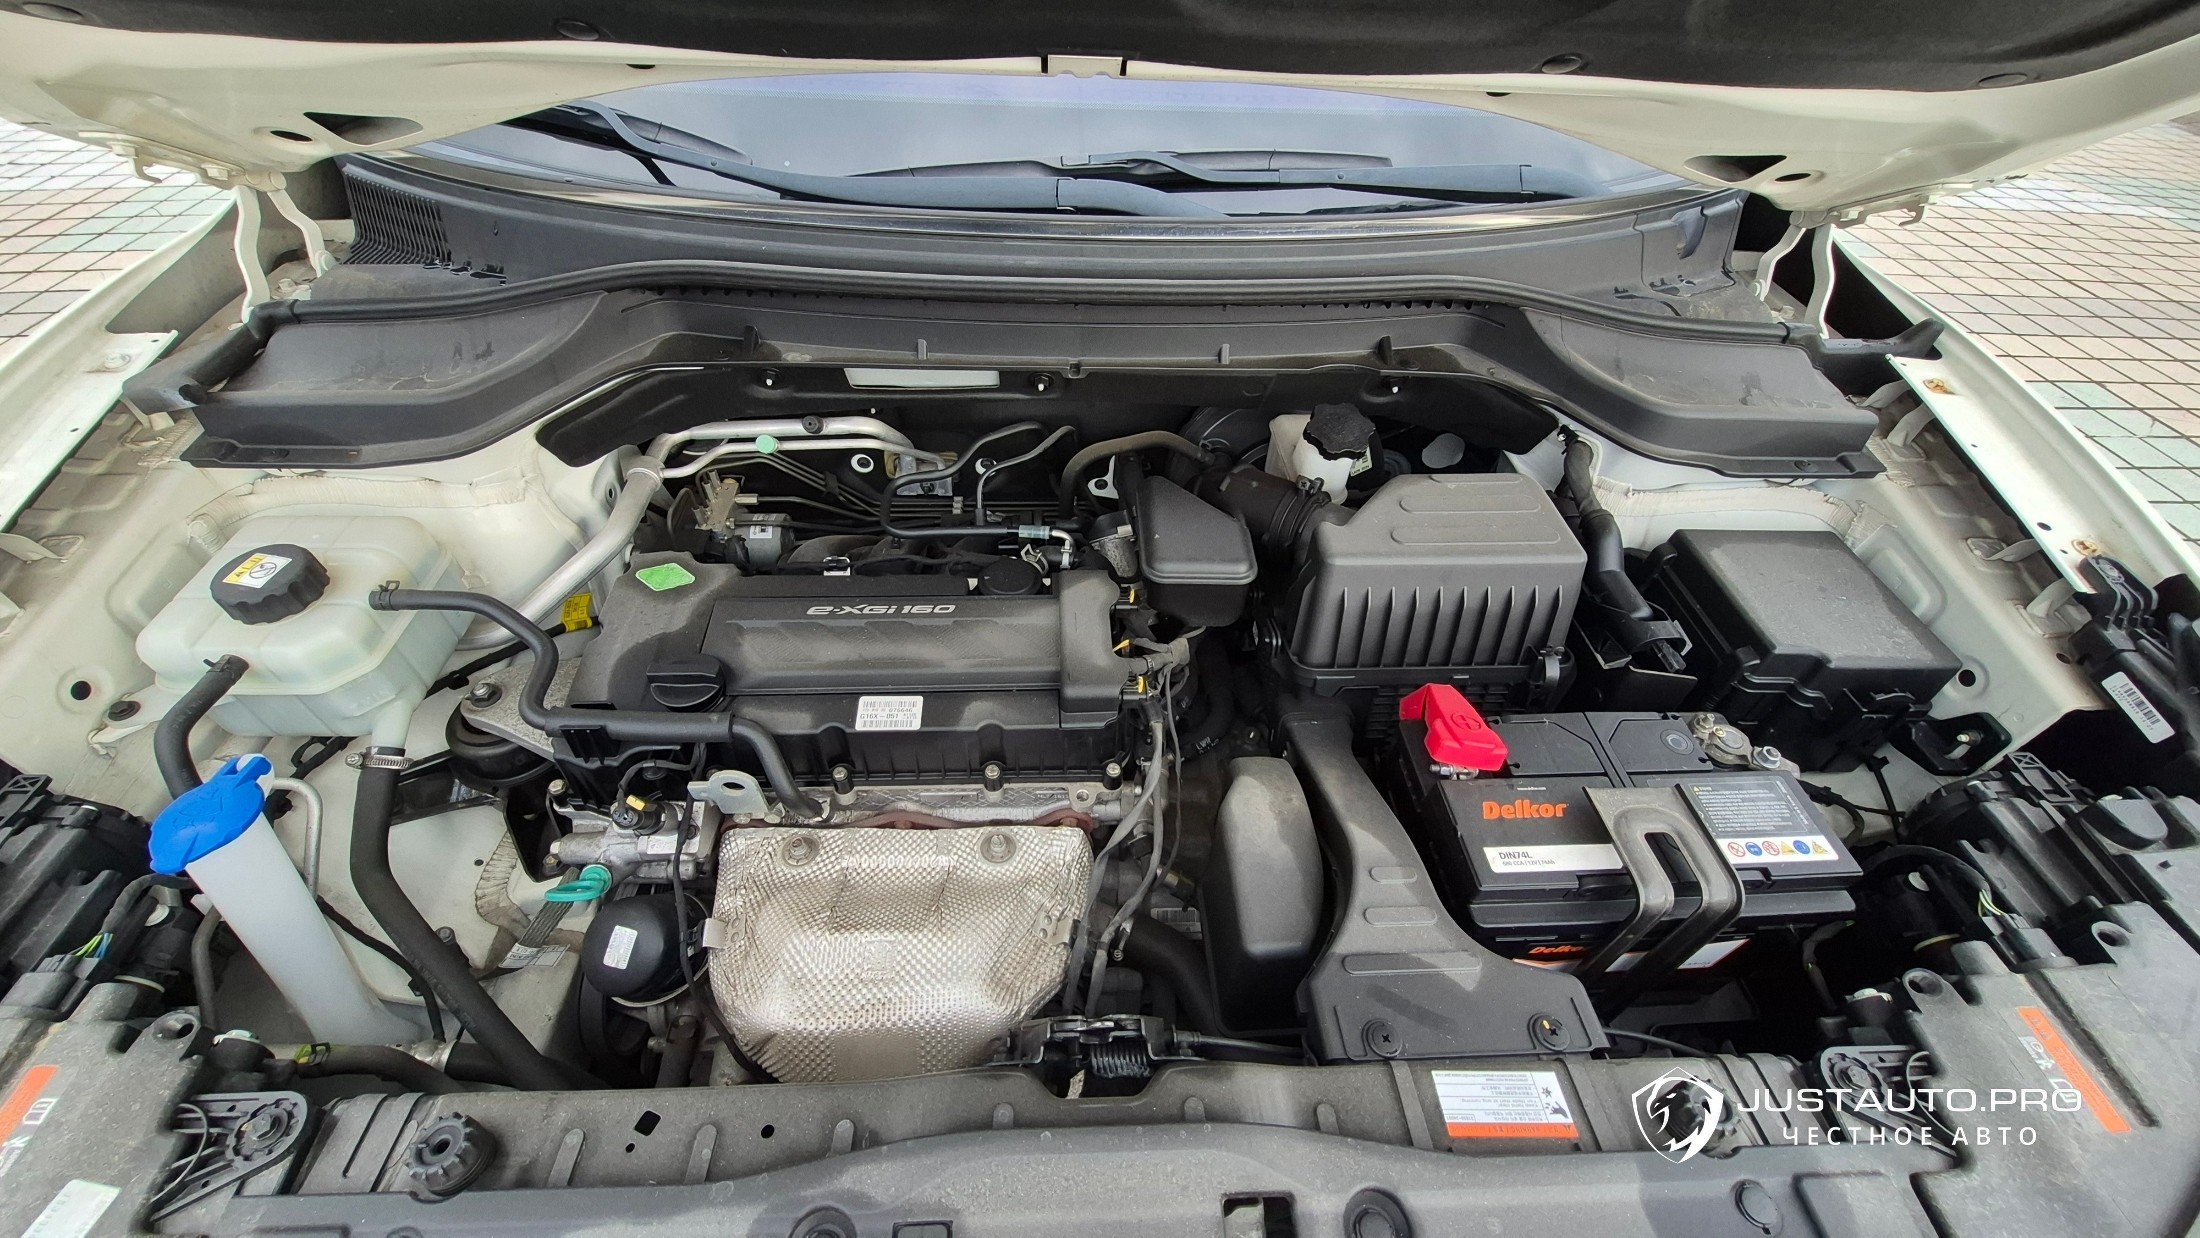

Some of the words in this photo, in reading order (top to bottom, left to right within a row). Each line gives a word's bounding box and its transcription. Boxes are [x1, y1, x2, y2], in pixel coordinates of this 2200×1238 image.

[901, 604, 956, 614] 160
[1482, 799, 1567, 819] Delkor
[1498, 851, 1533, 860] DIN74L
[1529, 945, 1585, 954] Delko
